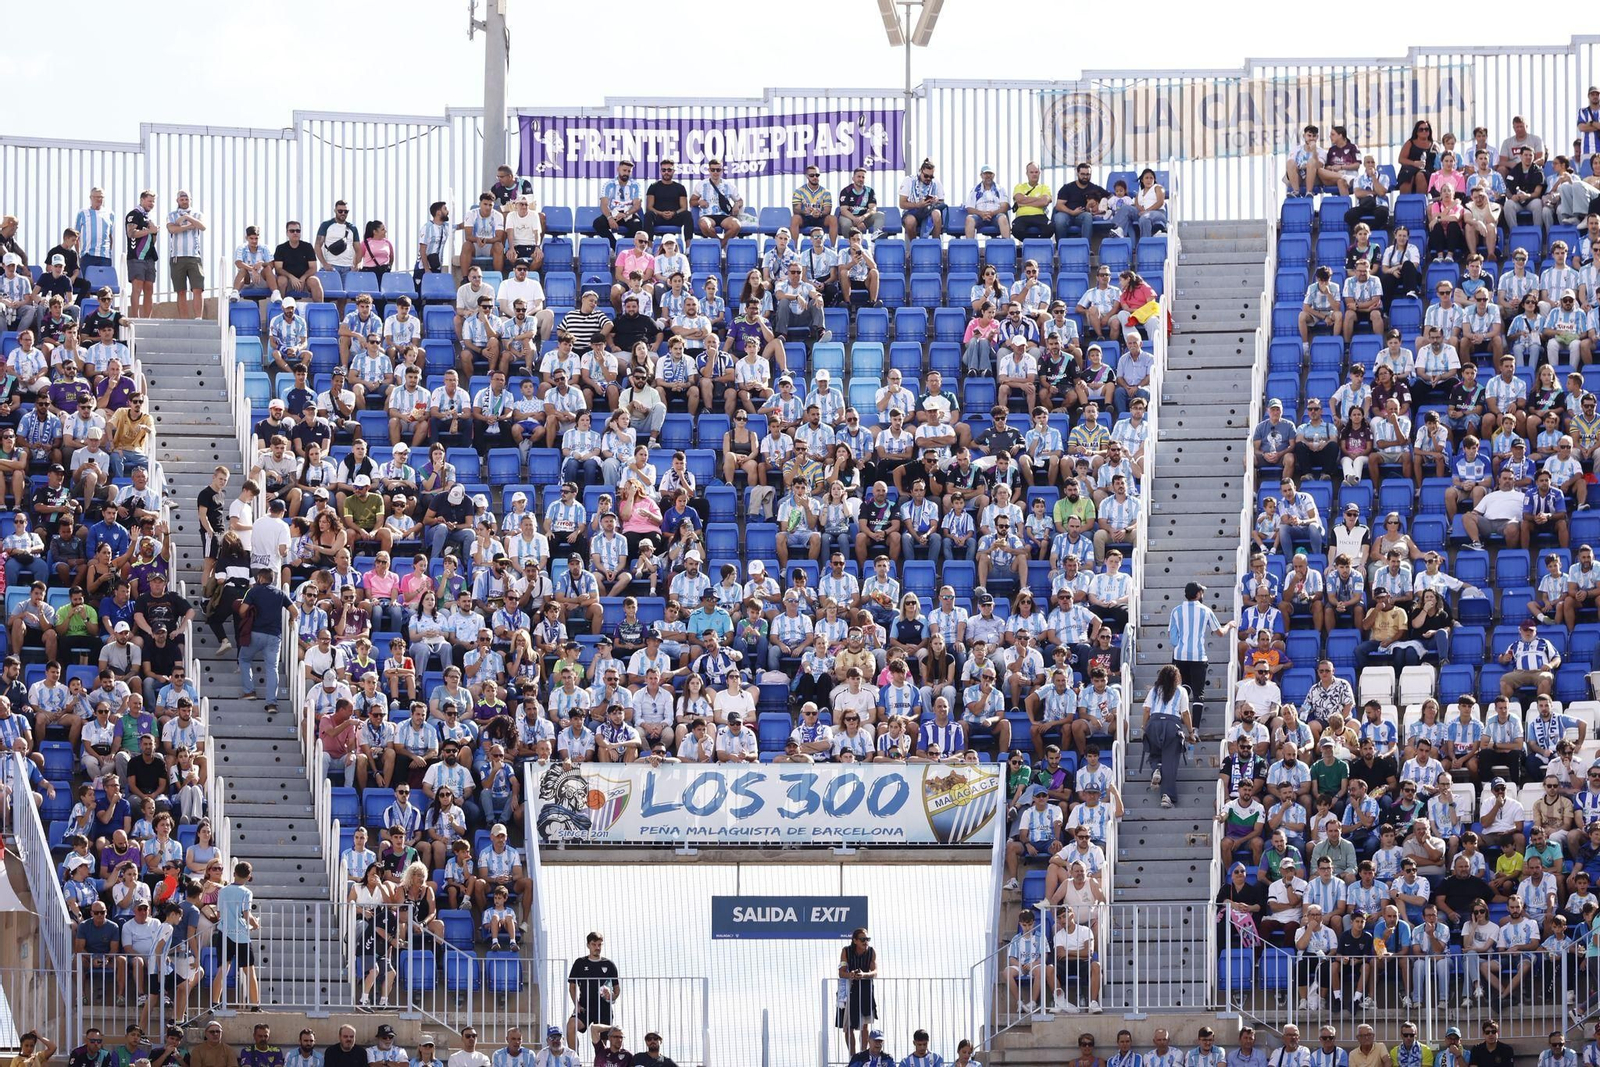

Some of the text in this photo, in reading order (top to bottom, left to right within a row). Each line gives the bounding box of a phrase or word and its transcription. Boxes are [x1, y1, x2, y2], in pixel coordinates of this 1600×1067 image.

[1125, 77, 1467, 134] LA CARIHUELA
[566, 120, 855, 164] FRENTE COMEPIPAS
[1222, 122, 1374, 149] TORREMLIOS
[731, 161, 767, 174] 2007
[979, 778, 998, 790] C.F.
[640, 771, 910, 819] LOS 300
[558, 830, 588, 838] SINCE
[640, 824, 904, 836] PEÑA MALAGUISTA DE BARCELONA
[732, 906, 850, 923] SALIDA EXIT
